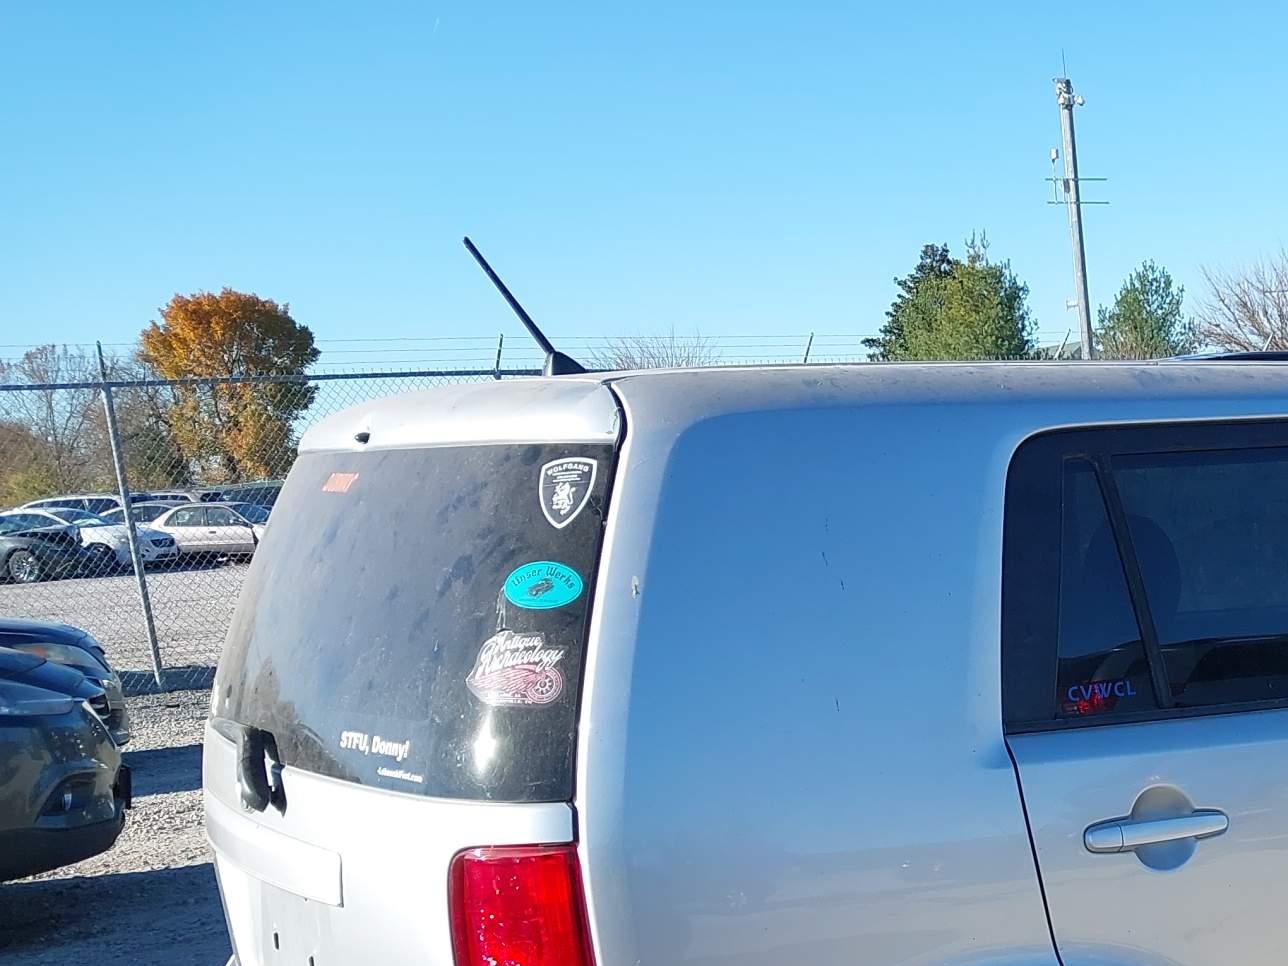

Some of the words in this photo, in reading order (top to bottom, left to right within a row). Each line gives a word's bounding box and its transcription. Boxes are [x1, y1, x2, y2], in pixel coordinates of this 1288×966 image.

[546, 462, 590, 476] WOLFGANG
[546, 565, 576, 589] Werks
[492, 630, 543, 654] Antique
[340, 730, 369, 755] STFU,
[371, 735, 410, 762] Donny!
